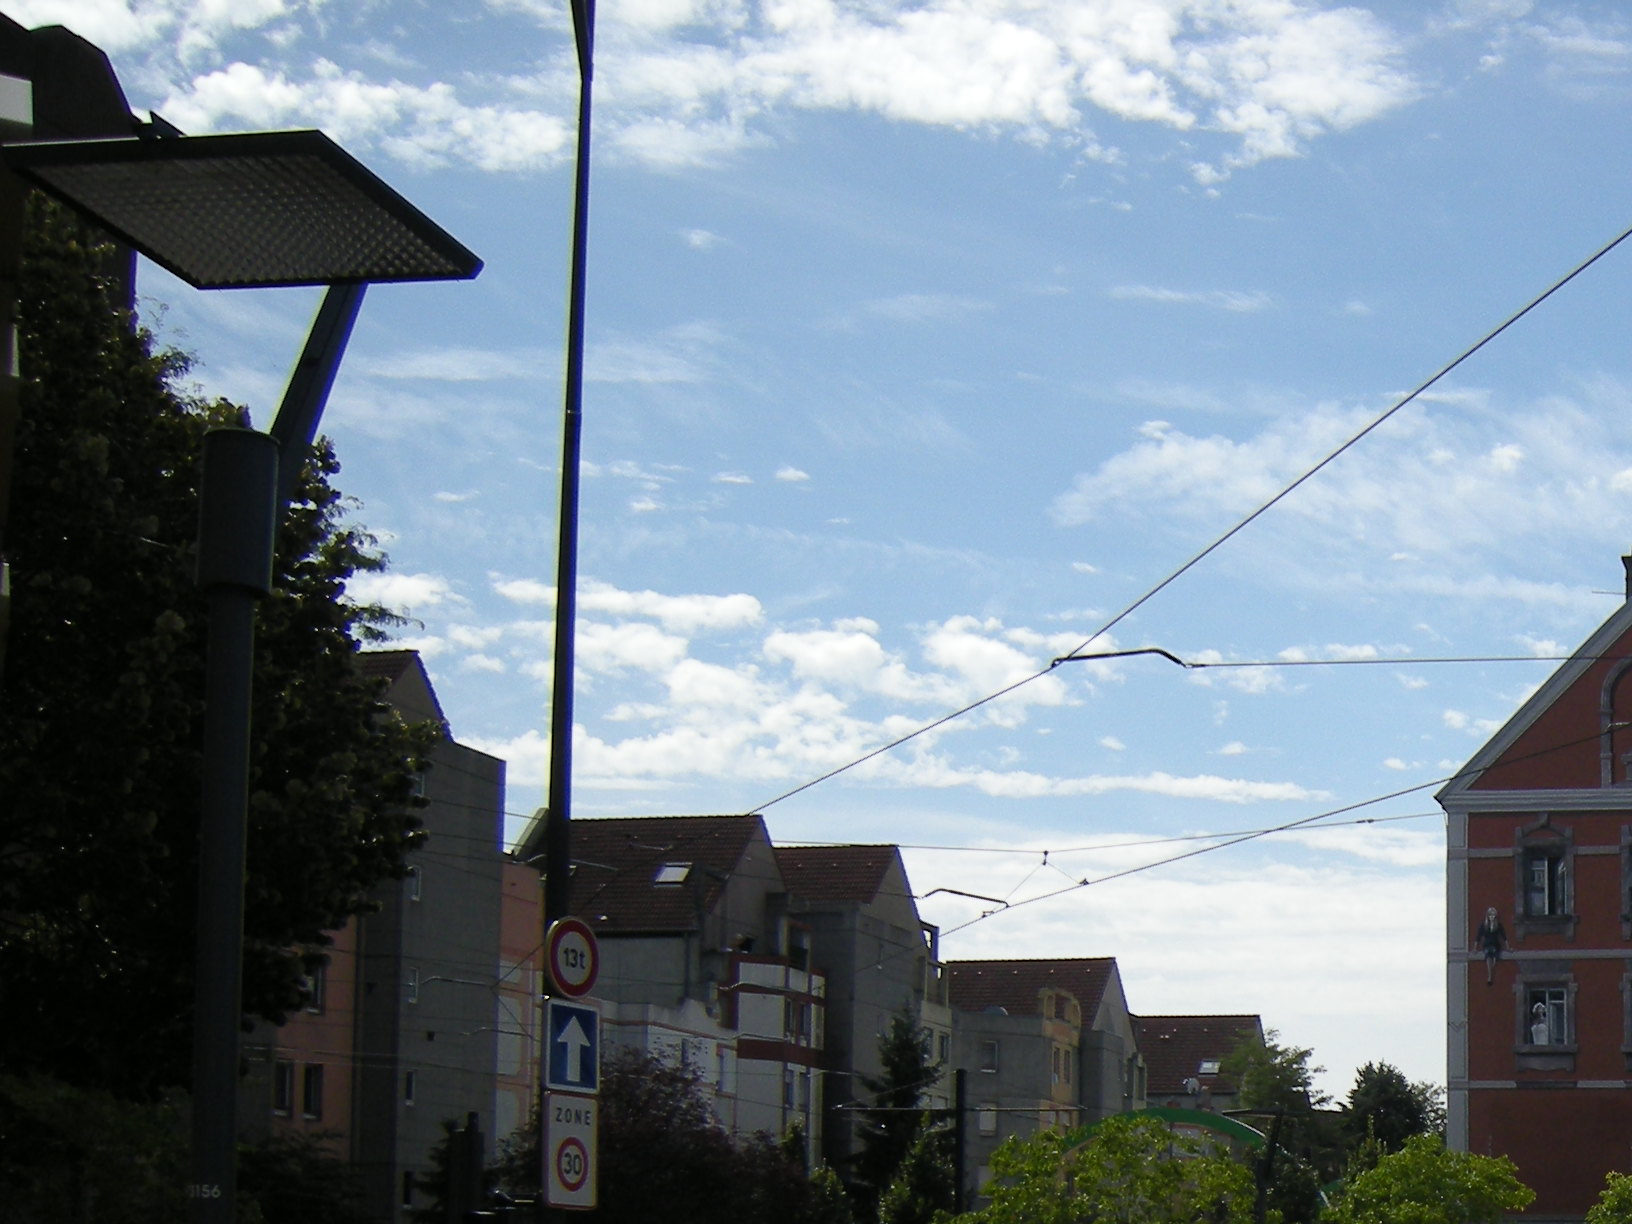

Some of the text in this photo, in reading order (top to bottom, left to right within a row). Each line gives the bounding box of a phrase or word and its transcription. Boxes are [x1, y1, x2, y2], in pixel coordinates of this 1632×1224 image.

[564, 948, 585, 969] 13t
[556, 1107, 591, 1125] ZONE
[564, 1152, 582, 1175] 30
